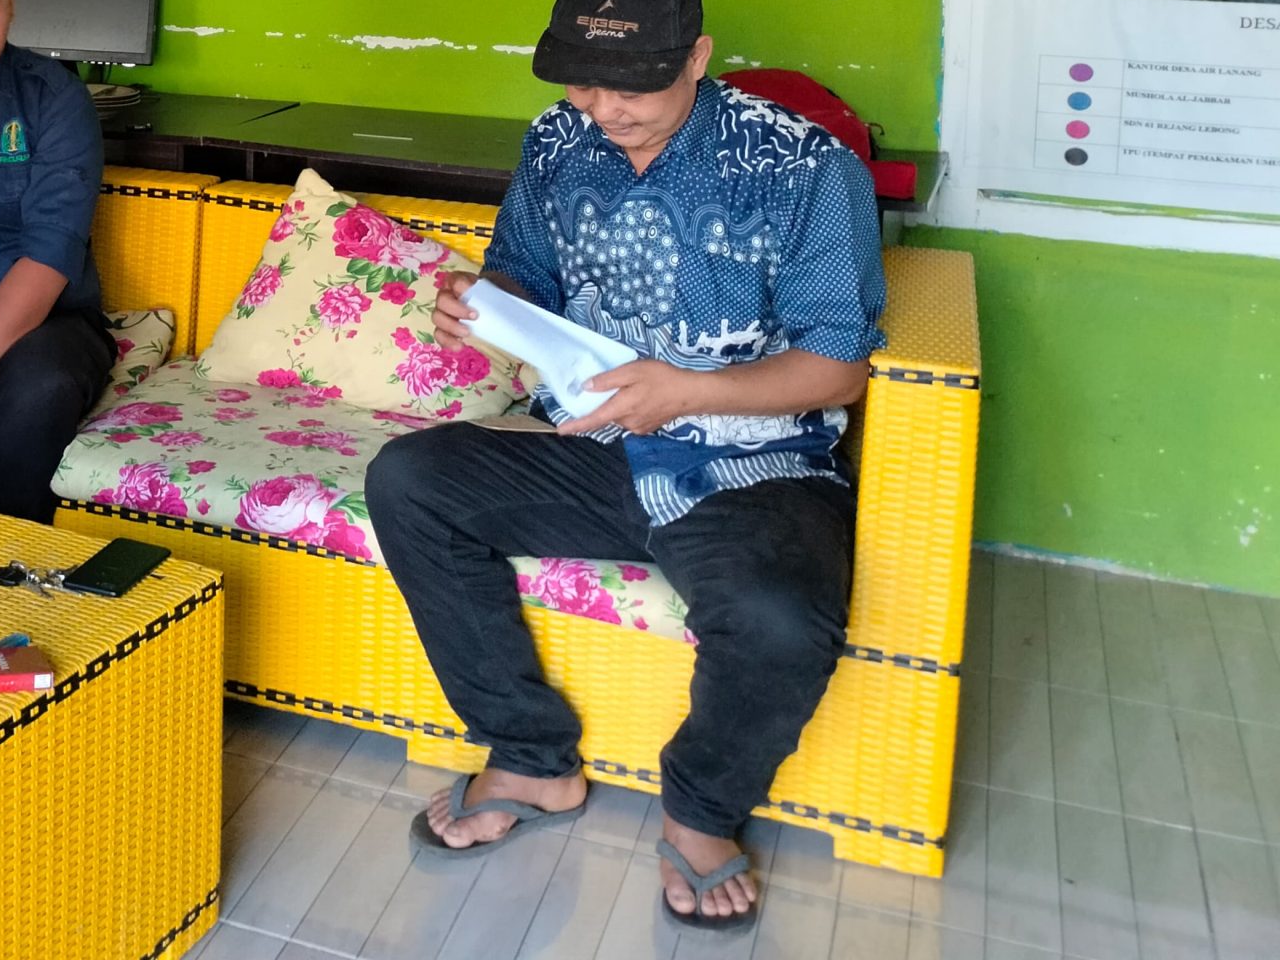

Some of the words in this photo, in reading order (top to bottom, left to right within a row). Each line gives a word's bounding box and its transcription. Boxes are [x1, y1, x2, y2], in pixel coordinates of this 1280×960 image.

[576, 15, 639, 33] EIGER
[585, 25, 626, 39] Jeans
[1127, 62, 1169, 72] KANTOR
[1171, 65, 1196, 74] DESA
[1198, 66, 1217, 75] AIR
[1218, 68, 1262, 78] LANANG
